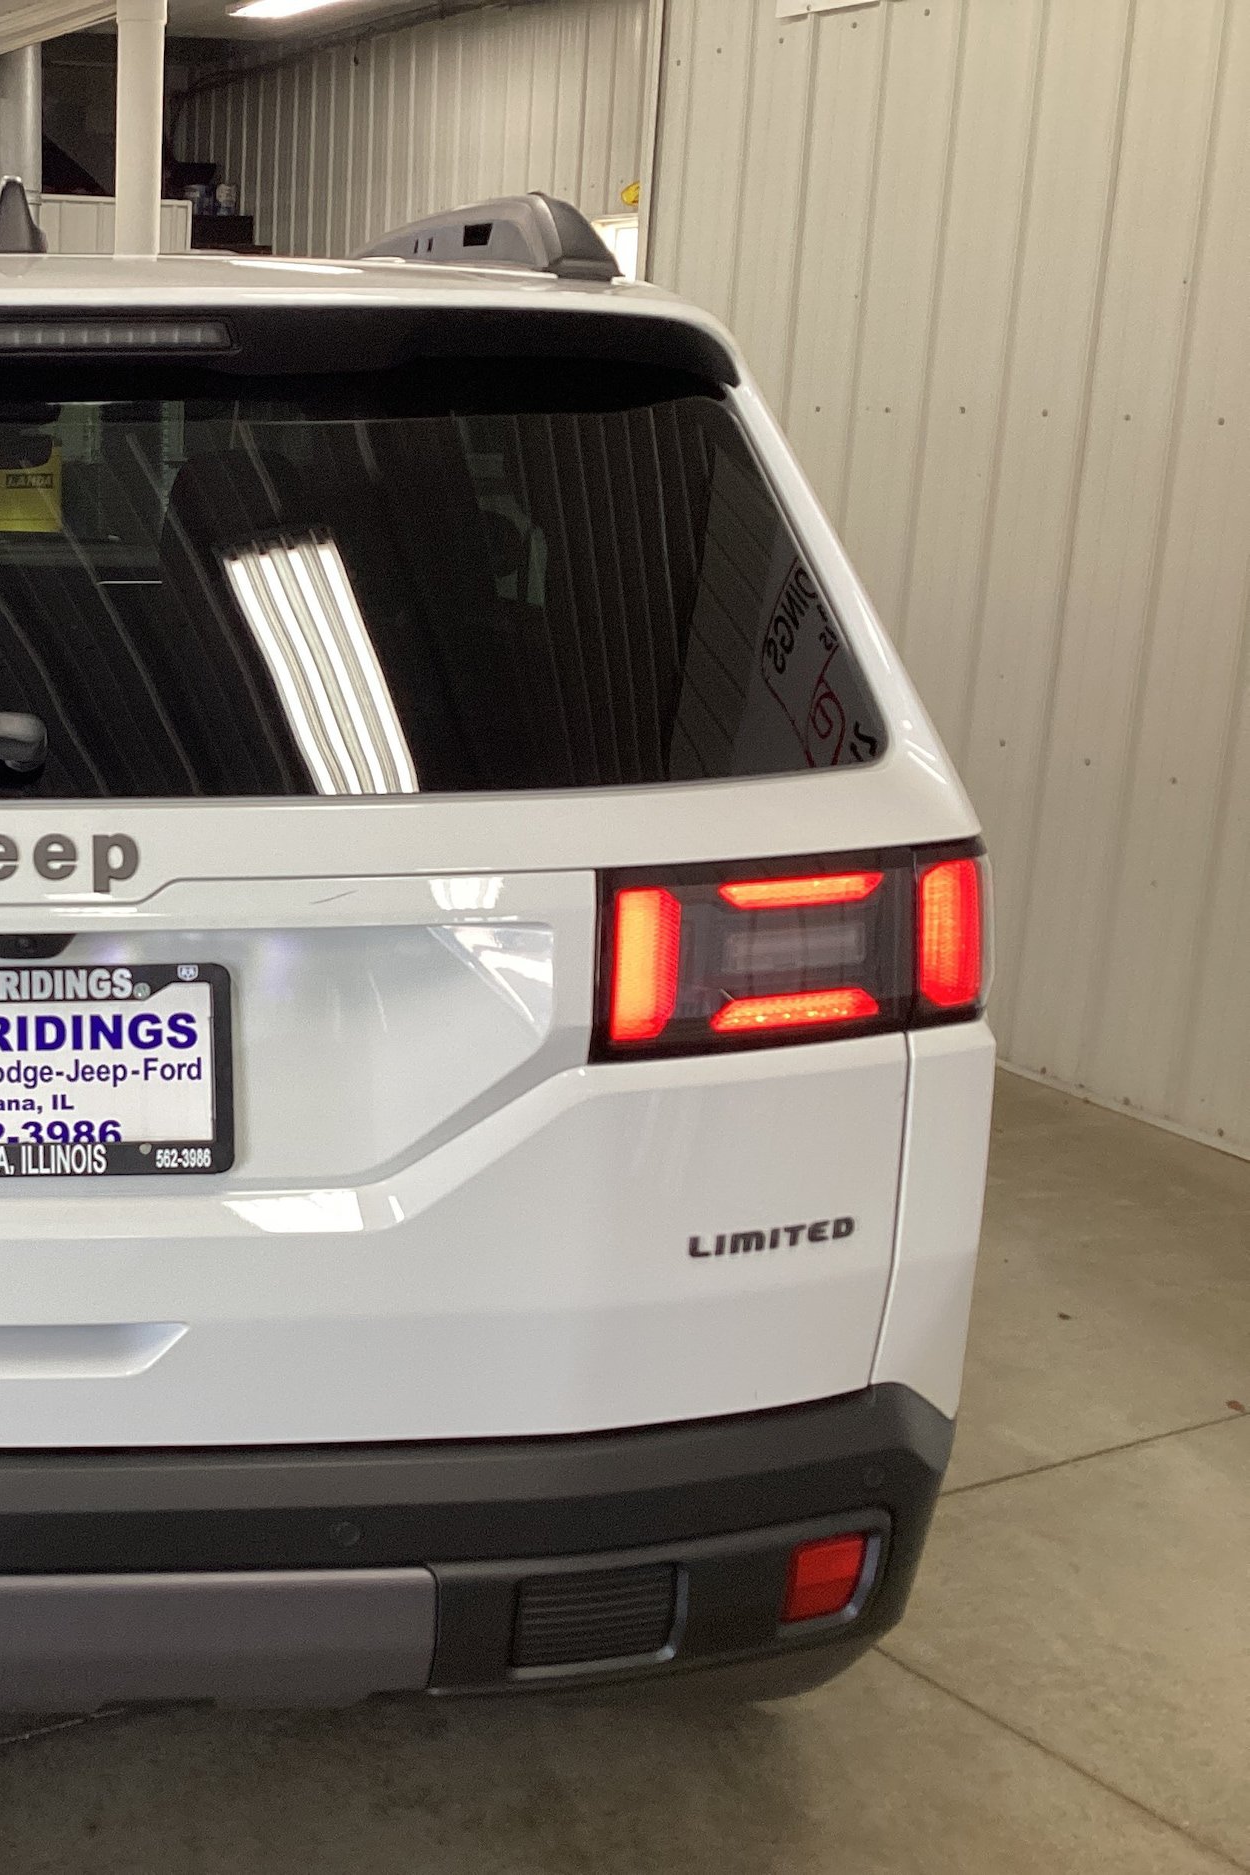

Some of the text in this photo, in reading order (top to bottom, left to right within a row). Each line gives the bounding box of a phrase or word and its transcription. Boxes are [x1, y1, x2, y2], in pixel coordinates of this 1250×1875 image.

[52, 1094, 75, 1111] IL
[21, 1144, 107, 1175] ILLINOIS
[155, 1148, 212, 1169] 562-3986
[688, 1216, 856, 1258] LIMITED
